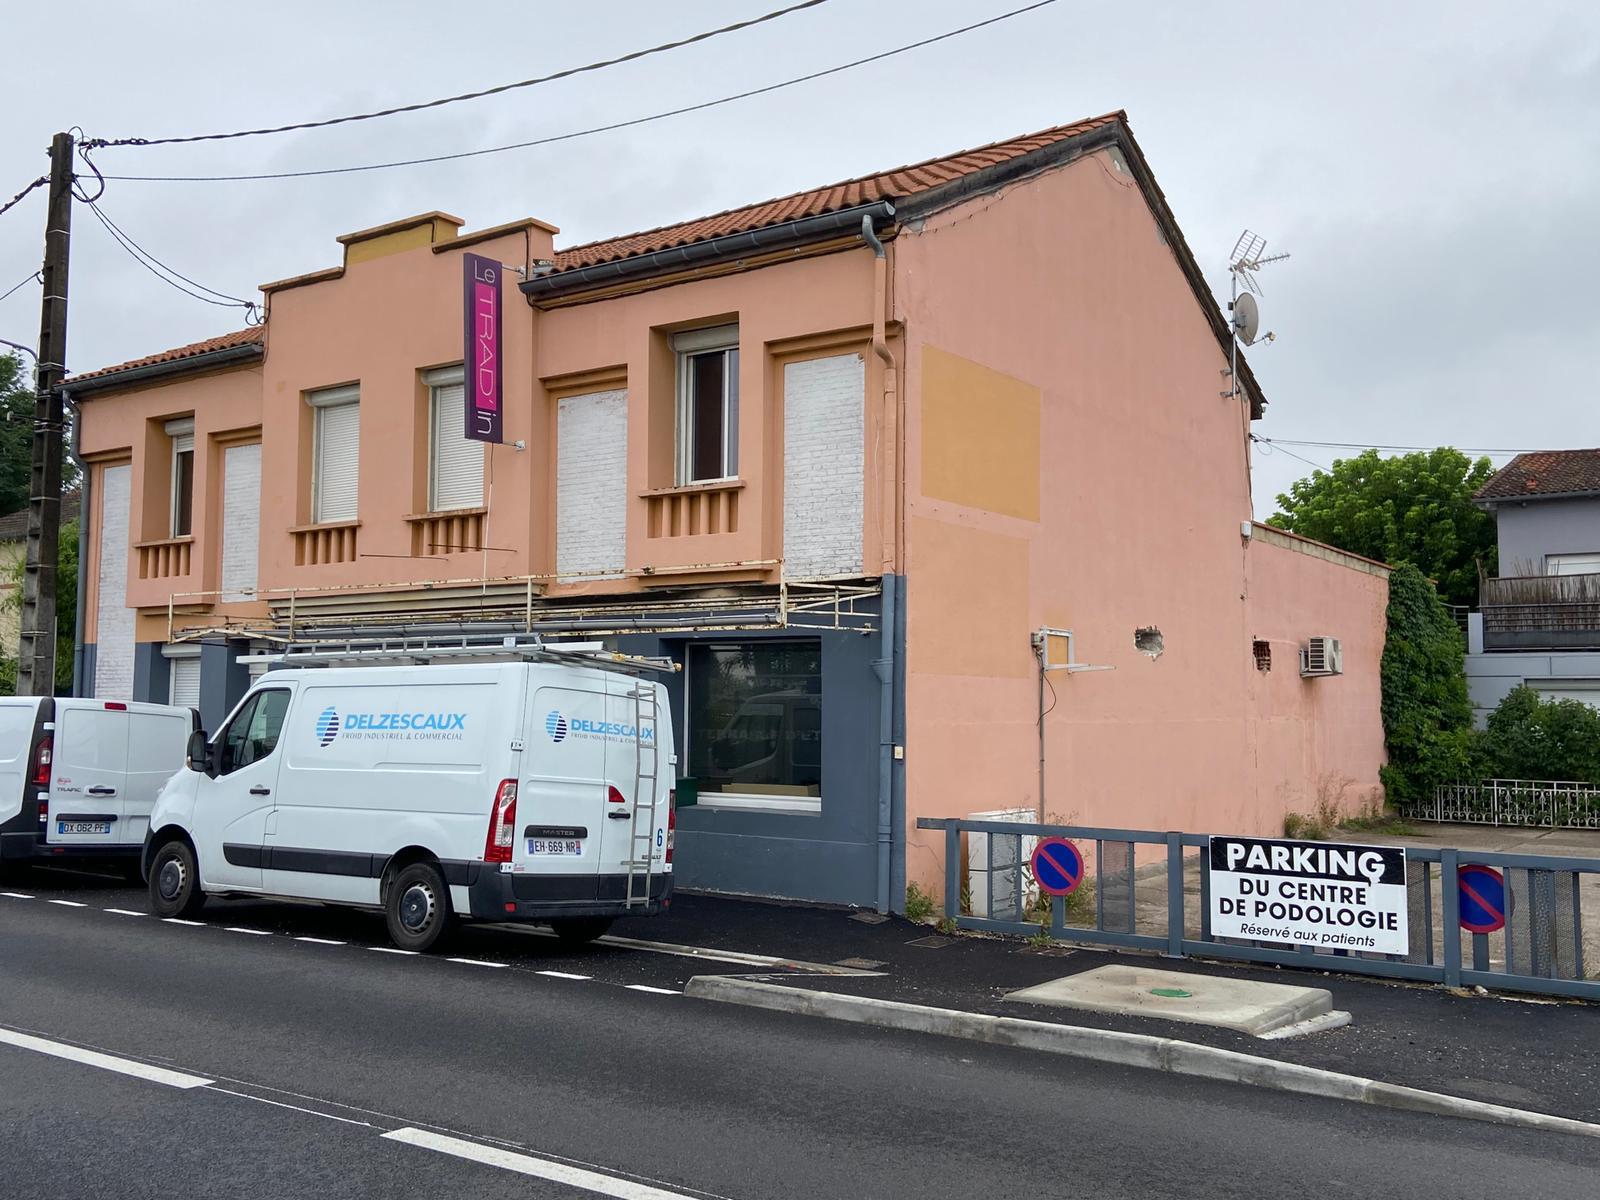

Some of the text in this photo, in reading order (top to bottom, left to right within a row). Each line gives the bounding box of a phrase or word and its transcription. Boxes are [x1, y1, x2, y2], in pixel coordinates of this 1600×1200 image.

[344, 713, 467, 730] DELZESCAUX
[342, 732, 362, 740] FROID
[364, 732, 403, 740] INDUSTRIEL
[414, 732, 464, 741] COMMERCIAL
[657, 827, 663, 847] 6
[1226, 842, 1386, 883] PARKING
[1239, 877, 1367, 906] DU CENTRE
[1219, 897, 1398, 931] DE PODOLOGIE
[1240, 923, 1376, 948] Réservé aux patients
